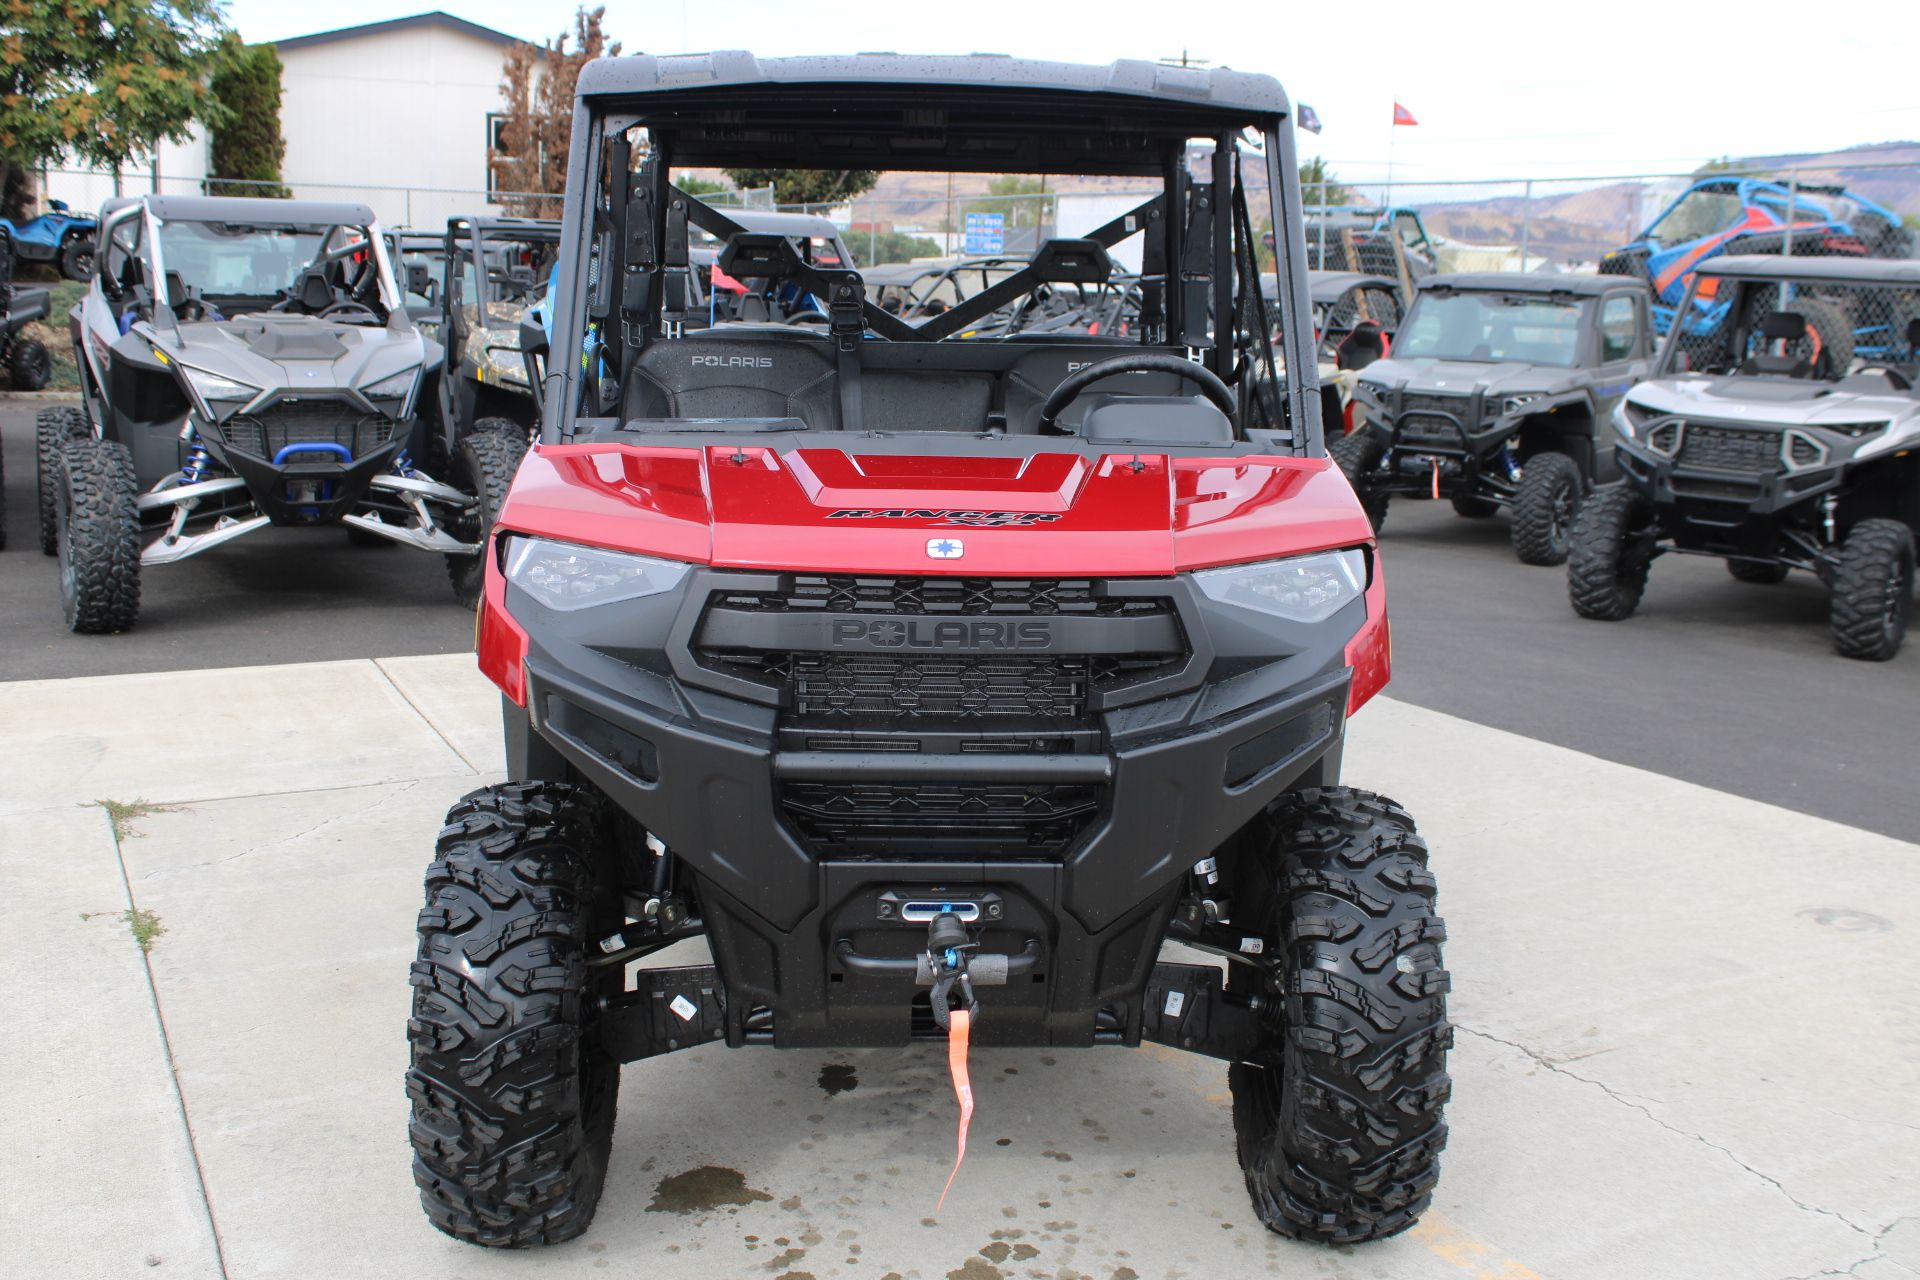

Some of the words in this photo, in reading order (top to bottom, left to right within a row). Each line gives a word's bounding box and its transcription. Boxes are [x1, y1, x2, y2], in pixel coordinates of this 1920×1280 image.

[691, 355, 773, 368] POLARIS
[824, 509, 1063, 522] RANGER
[927, 518, 1036, 527] XP
[833, 619, 1051, 650] POLARIS
